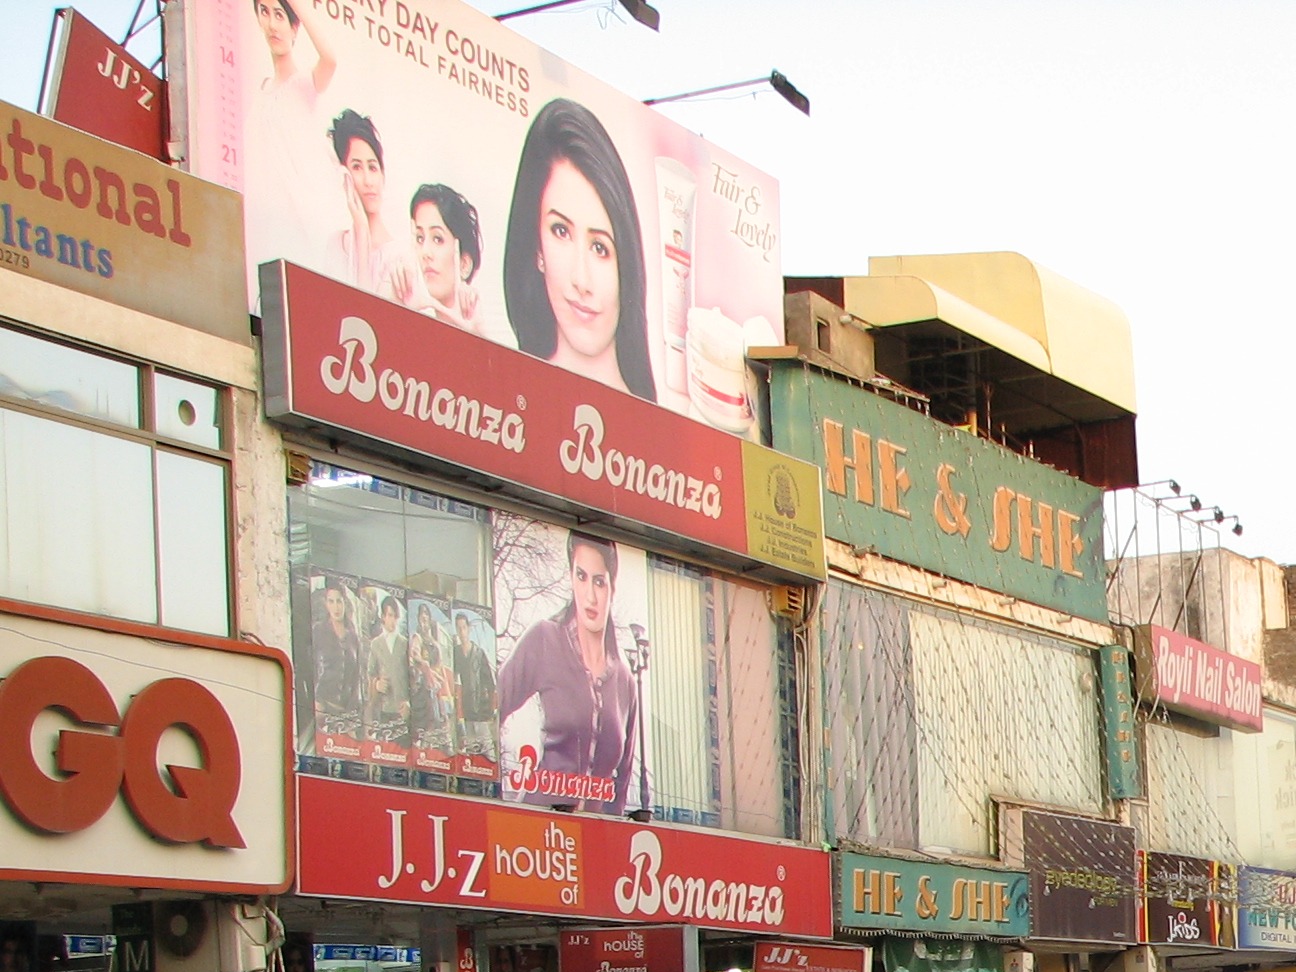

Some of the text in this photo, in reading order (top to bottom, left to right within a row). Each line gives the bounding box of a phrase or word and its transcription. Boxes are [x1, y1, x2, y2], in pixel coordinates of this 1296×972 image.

[220, 46, 235, 68] 14
[364, 16, 430, 68] TOTAL
[437, 55, 529, 118] FAIRNESS
[396, 1, 530, 93] DAY COUNTS
[222, 144, 237, 166] 21
[712, 162, 744, 206] Fair
[730, 209, 776, 263] Lovely
[320, 316, 527, 453] Bonanza
[558, 404, 722, 520] Bonanza
[822, 417, 911, 520] HE
[933, 462, 970, 538] &
[988, 485, 1084, 578] SHE
[1157, 635, 1261, 718] Royli Nail Salon
[0, 655, 247, 849] GQ
[509, 744, 618, 803] Bonanza
[545, 821, 575, 852] the
[560, 883, 580, 904] of
[614, 829, 786, 926] Bonanza
[853, 868, 1011, 923] HE & SHE
[124, 939, 149, 972] M
[1261, 931, 1293, 944] DIGITAL
